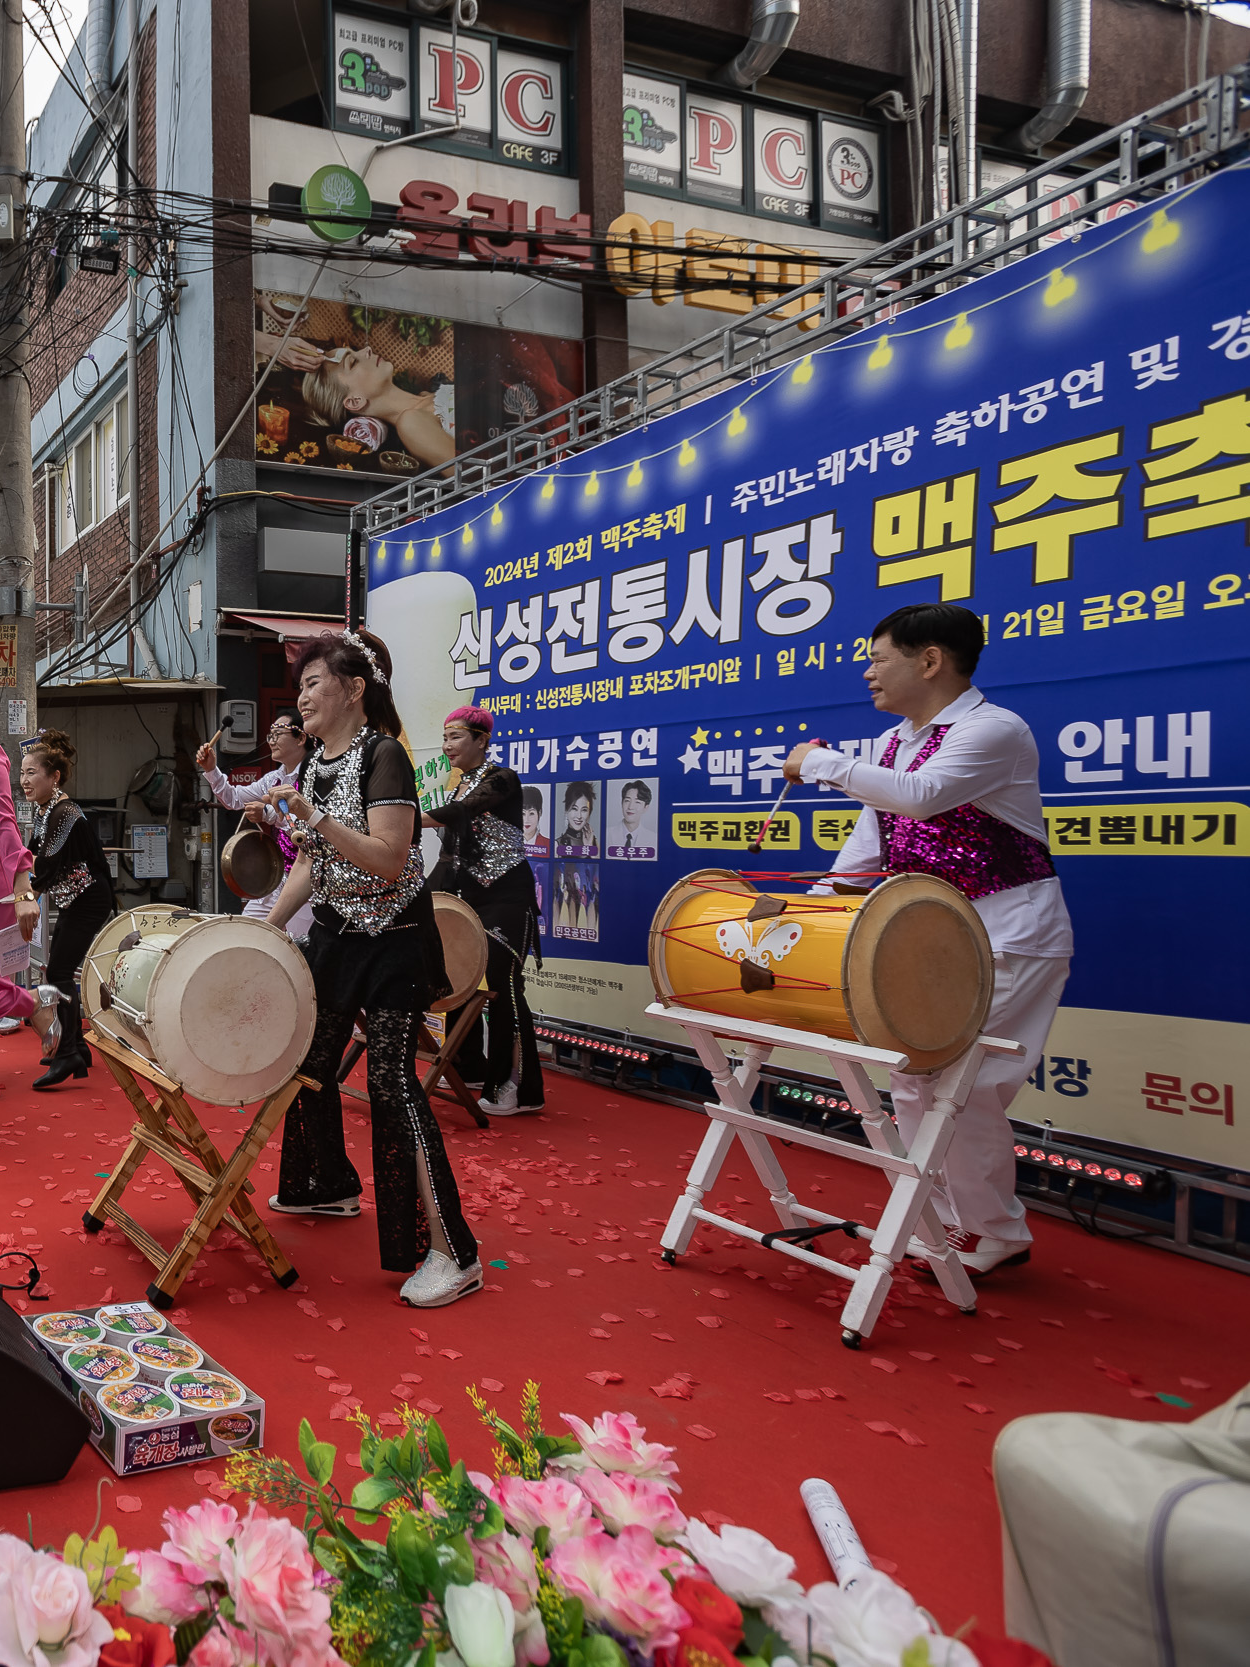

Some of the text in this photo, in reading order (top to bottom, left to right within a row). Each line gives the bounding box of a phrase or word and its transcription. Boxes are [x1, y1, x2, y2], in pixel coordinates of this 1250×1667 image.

[361, 33, 386, 49] 프리미엄
[622, 86, 637, 99] 고급
[503, 142, 558, 165] CAFE 3F
[762, 195, 810, 217] CAFE 3F
[484, 552, 539, 588] 2024년
[546, 535, 593, 572] 제2회
[600, 503, 687, 553] 맥주축제
[731, 426, 919, 514] 주민노래자랑
[931, 360, 1106, 447] 축하공연
[1128, 335, 1180, 391] 및
[450, 509, 844, 692] 신성전통시장
[480, 692, 522, 716] 행사무대
[535, 675, 623, 711] 신성전통시장내
[628, 656, 742, 697] 포차조개구이앞
[1002, 600, 1065, 640] 21일
[1079, 581, 1186, 631] 금요일
[1203, 573, 1250, 610] 오
[1058, 710, 1211, 783] 안내
[232, 773, 258, 784] NSOK
[678, 819, 791, 843] 맥주교환권
[1048, 812, 1237, 847] 견뽐내기
[556, 926, 596, 940] 민요공연단
[1141, 1071, 1235, 1127] 문의
[161, 1430, 180, 1441] 농심
[132, 1440, 180, 1466] 육개장
